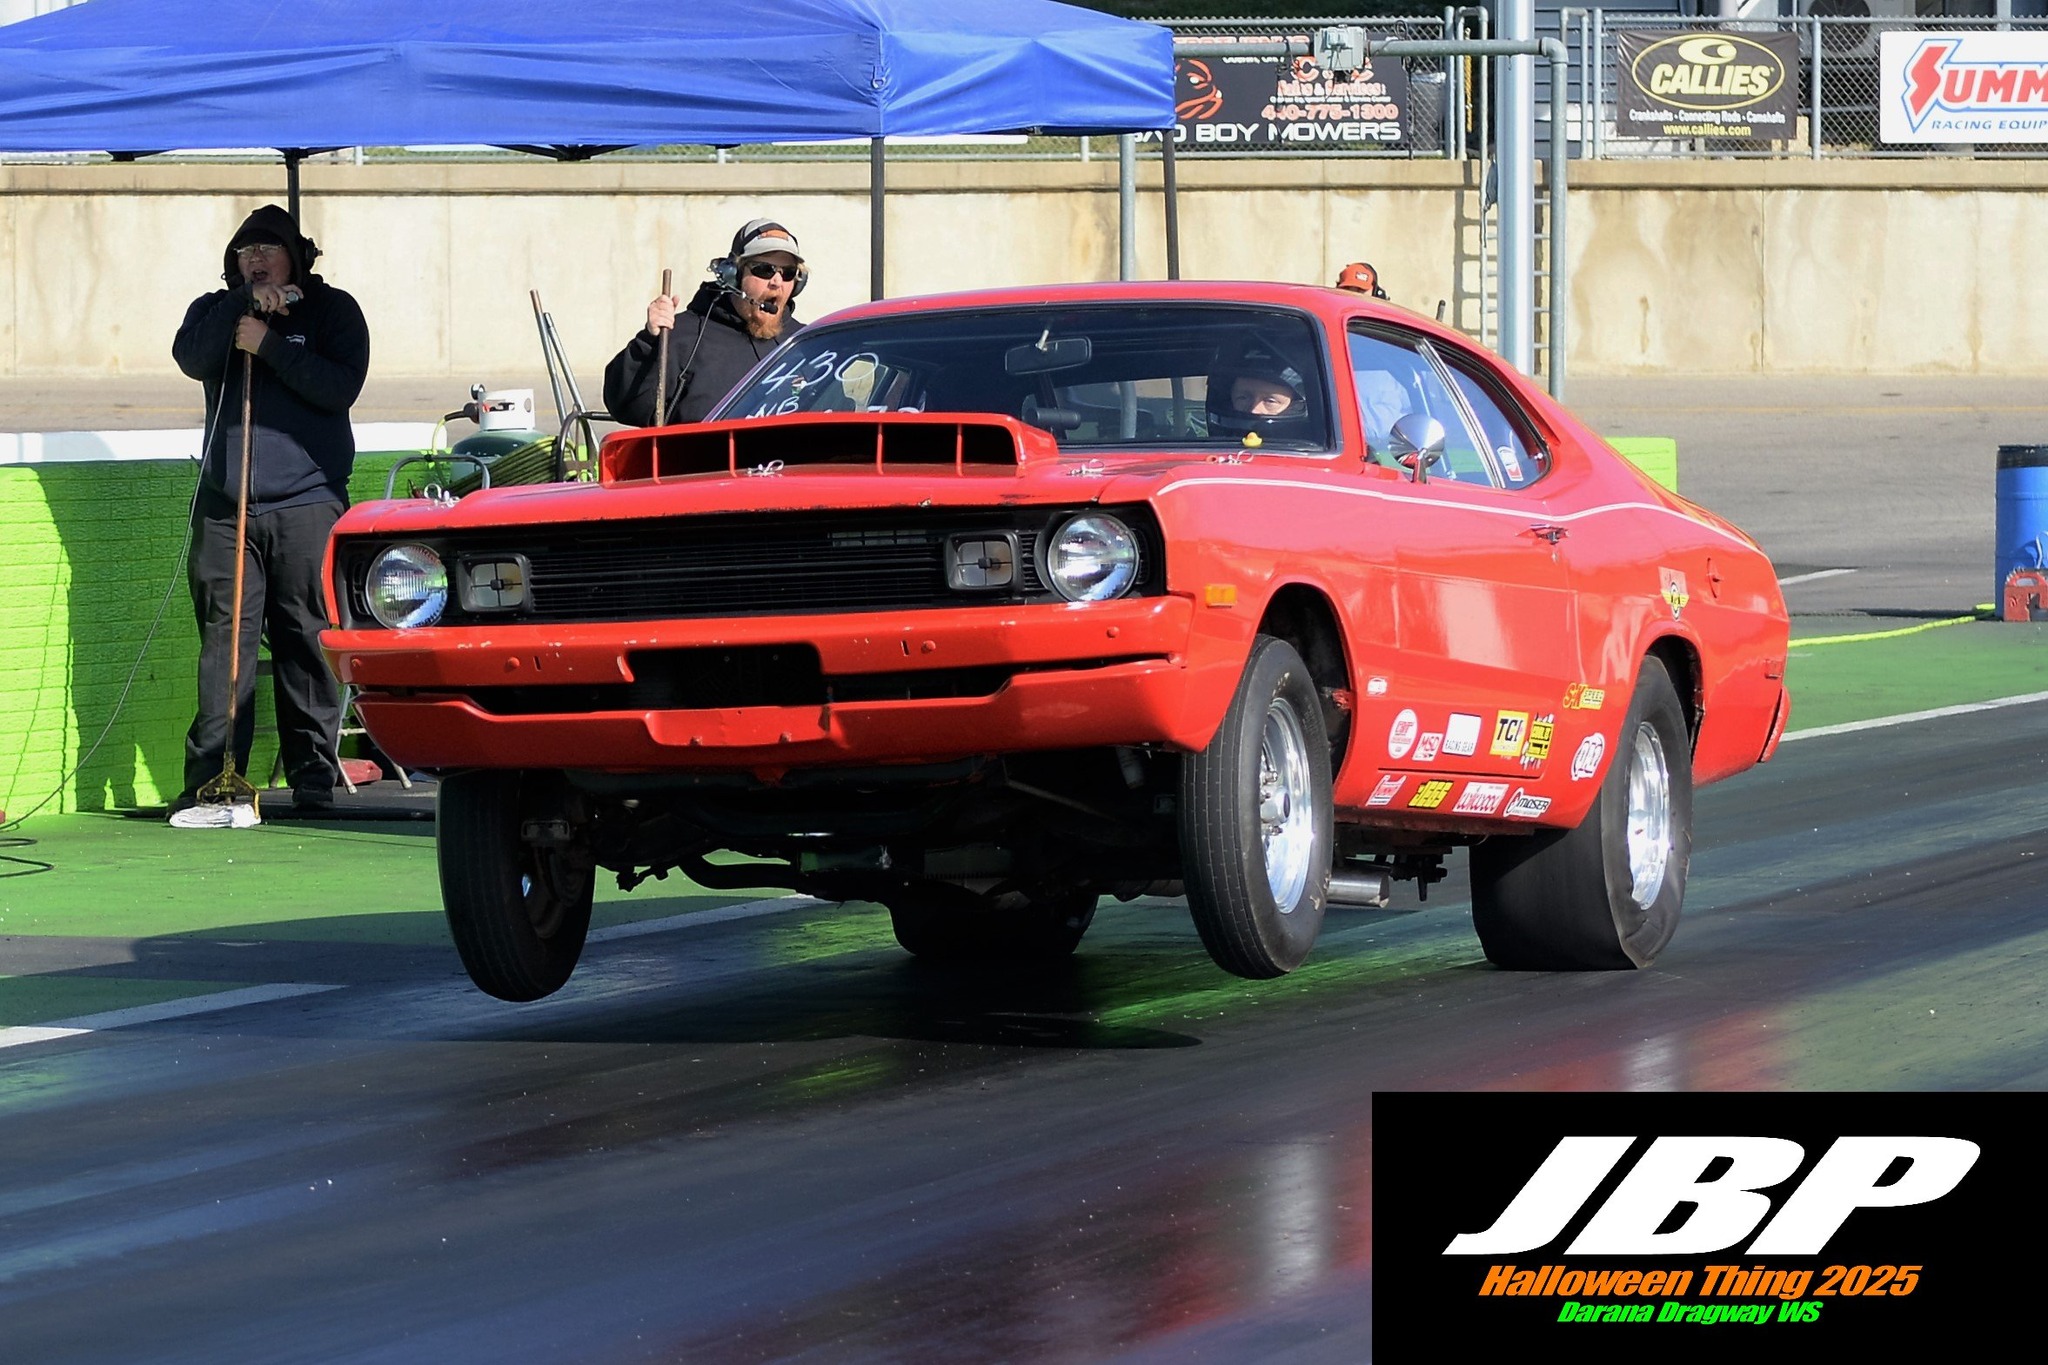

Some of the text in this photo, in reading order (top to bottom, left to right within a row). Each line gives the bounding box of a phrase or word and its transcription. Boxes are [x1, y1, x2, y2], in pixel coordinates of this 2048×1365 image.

[1651, 63, 1771, 96] CALLIES
[1629, 109, 1786, 125] Crankshafts Connecting Rods Camshafts
[1932, 120, 2048, 130] RACING EQUIP
[1195, 123, 1259, 142] BOY
[1268, 121, 1401, 142] MOWERS
[1663, 123, 1751, 136] www.callies.com
